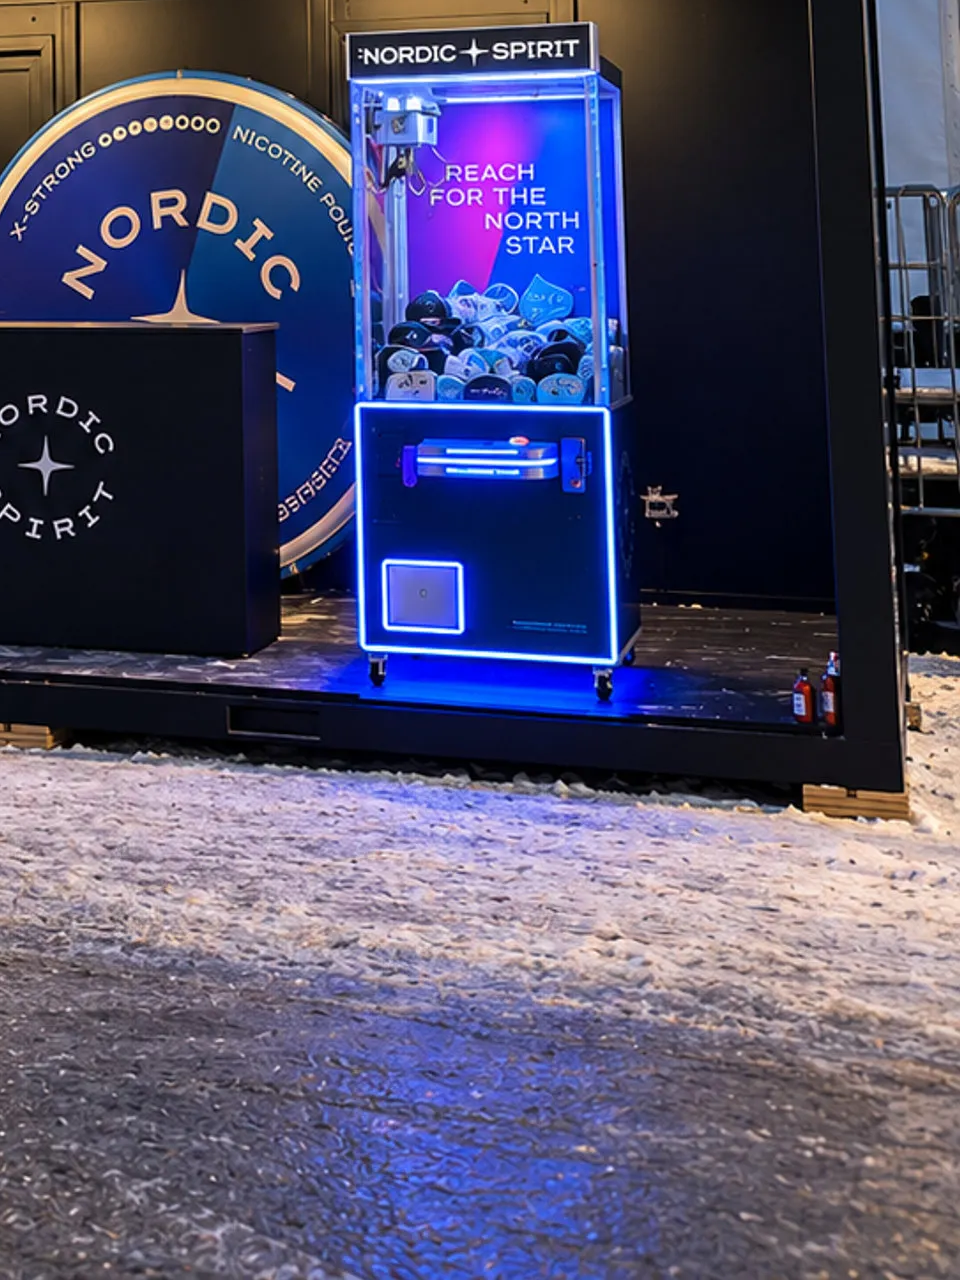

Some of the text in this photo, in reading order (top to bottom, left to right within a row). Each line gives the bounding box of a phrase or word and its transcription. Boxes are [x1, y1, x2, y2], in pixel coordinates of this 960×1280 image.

[492, 39, 580, 60] SPIRIT
[232, 125, 324, 193] NICOTINE
[445, 163, 534, 182] REACH
[10, 141, 96, 241] X-STRONG
[430, 187, 546, 206] FOR THE
[484, 211, 580, 230] NORTH
[61, 188, 301, 300] NORDIC
[506, 236, 575, 255] STAR
